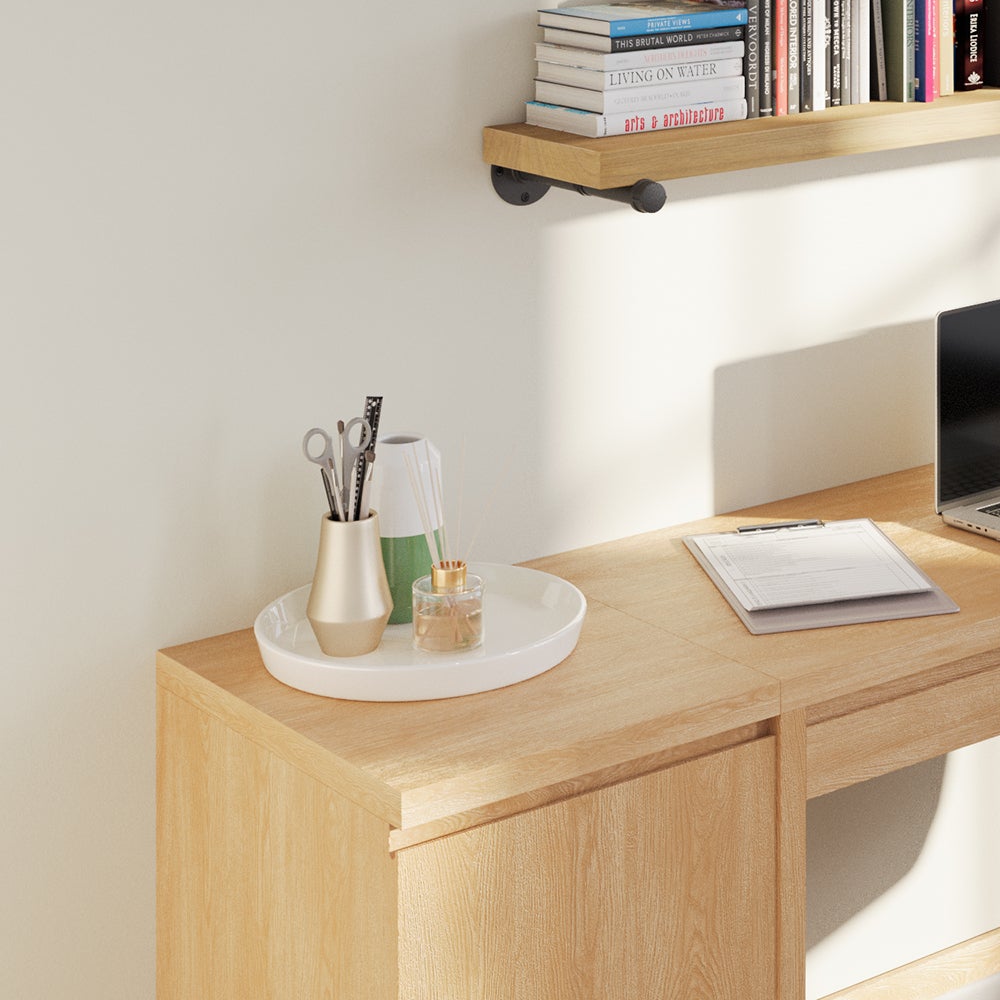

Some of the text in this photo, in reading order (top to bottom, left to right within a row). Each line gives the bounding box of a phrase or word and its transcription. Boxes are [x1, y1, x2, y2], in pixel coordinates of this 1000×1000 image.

[647, 18, 691, 28] PRIVATE VIEWS
[969, 14, 979, 33] ERIKA
[616, 40, 633, 49] THIS
[636, 37, 664, 46] BRUTAL
[667, 34, 693, 44] WORLD
[748, 6, 757, 89] VERVOORDT
[789, 27, 797, 69] INTERIOR
[969, 34, 979, 63] LIODICE
[610, 63, 717, 85] LIVING ON WATER
[625, 116, 645, 132] arts
[651, 117, 658, 129] &
[663, 107, 724, 127] architecture
